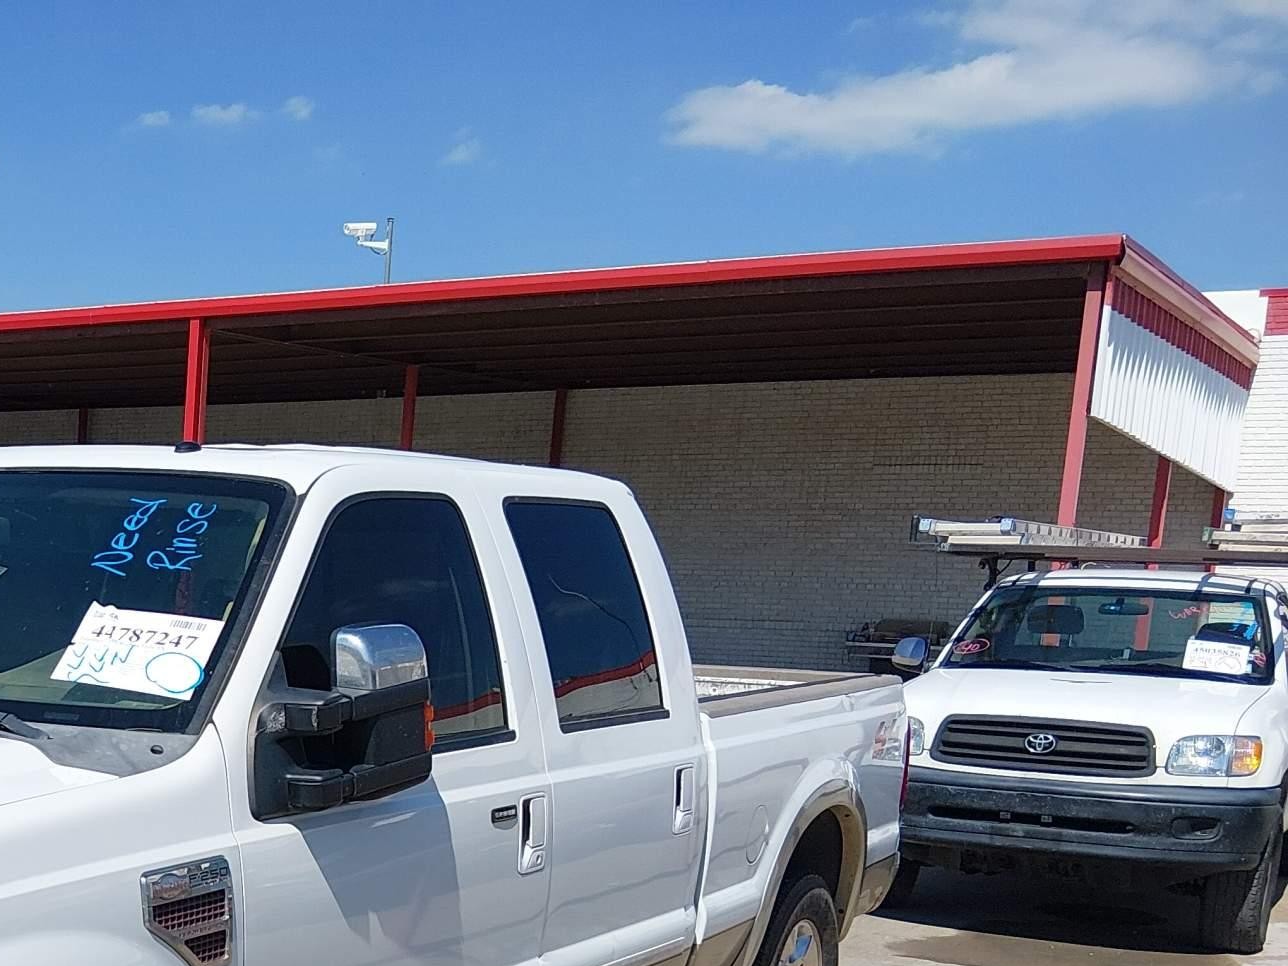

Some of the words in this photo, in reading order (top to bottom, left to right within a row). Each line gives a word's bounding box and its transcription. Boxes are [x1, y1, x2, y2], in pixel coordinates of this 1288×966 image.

[91, 498, 167, 576] Need
[146, 502, 217, 571] Rinse
[91, 624, 200, 650] 44787247
